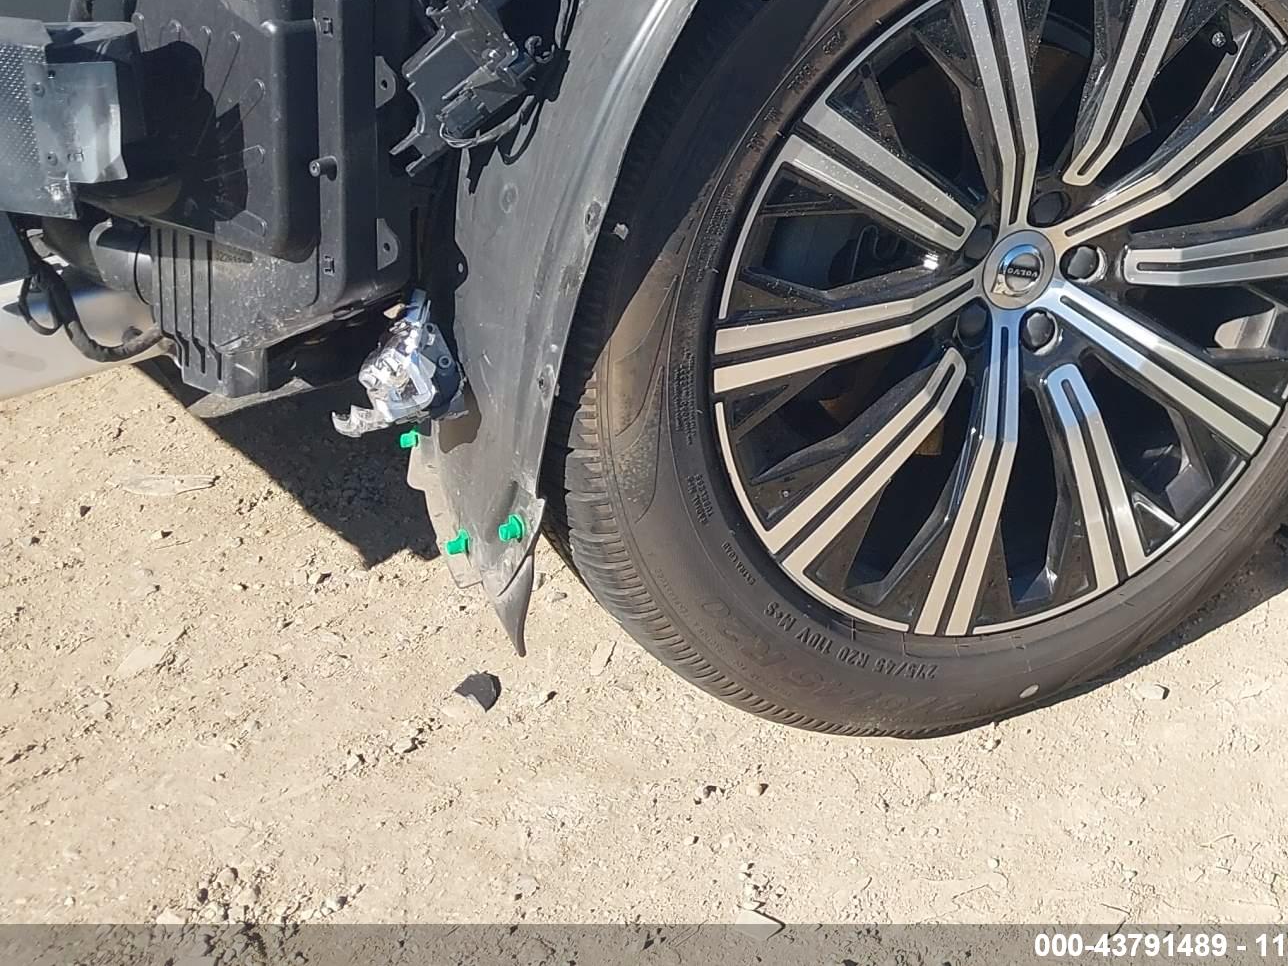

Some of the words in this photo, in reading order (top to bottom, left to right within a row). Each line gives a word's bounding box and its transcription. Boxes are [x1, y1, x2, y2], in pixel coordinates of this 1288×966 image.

[1007, 266, 1038, 278] VOLVO
[799, 626, 835, 655] 110V
[836, 646, 871, 670] R20
[870, 656, 939, 680] 275/45
